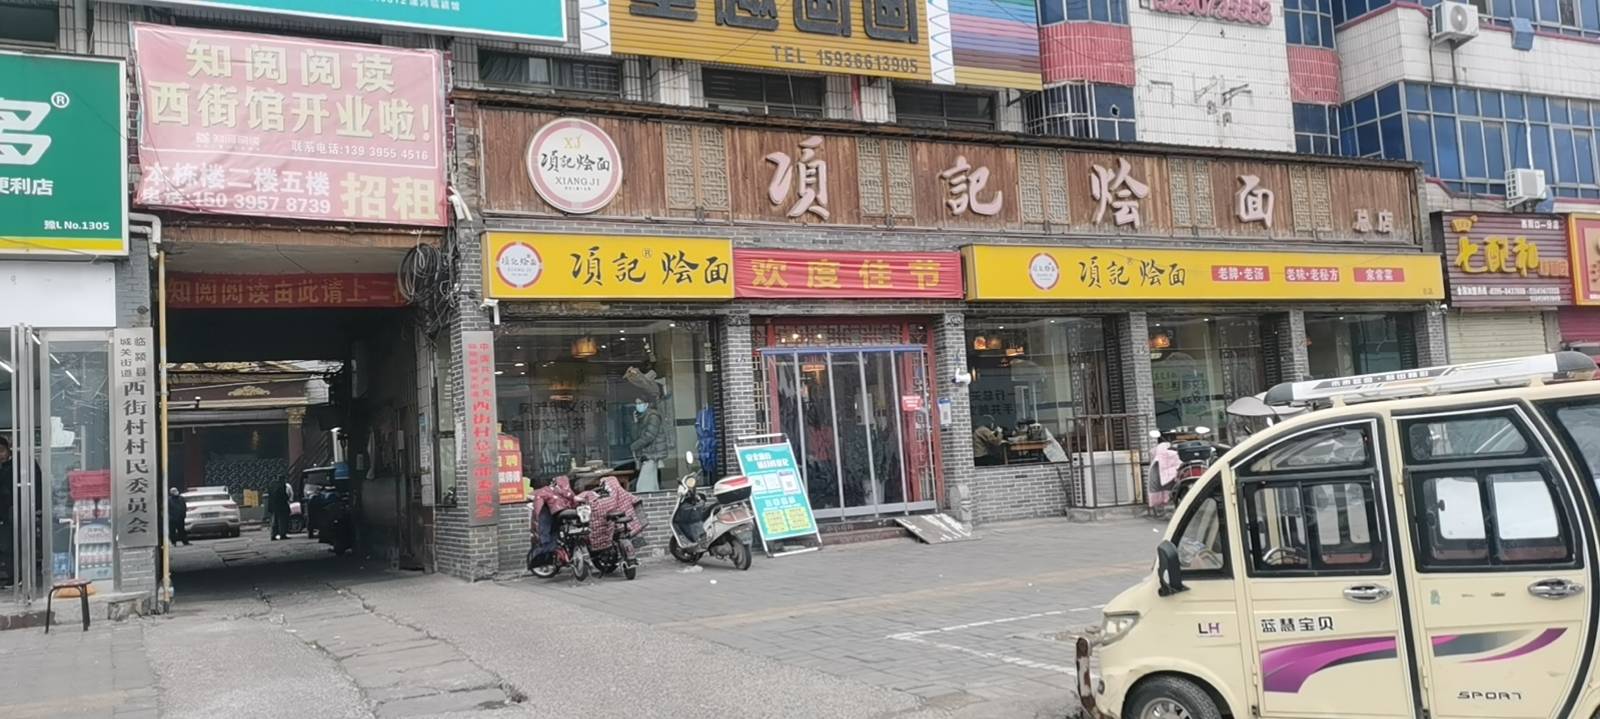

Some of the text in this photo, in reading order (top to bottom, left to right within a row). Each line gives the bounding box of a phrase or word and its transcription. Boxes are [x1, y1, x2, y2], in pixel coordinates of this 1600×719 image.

[185, 38, 395, 94] 知阅阅读
[771, 45, 918, 74] TEL 15936613905
[148, 81, 430, 142] 西街馆开业啦!
[369, 146, 397, 159] 3955
[401, 150, 429, 161] 4516
[144, 162, 331, 197] 本栋楼二楼五楼
[555, 176, 600, 187] XIANG JI
[233, 193, 279, 211] 3957
[286, 196, 332, 214] 8739
[339, 171, 441, 221] 招租
[64, 220, 110, 231] No.1305
[750, 257, 941, 290] 欢度佳节
[123, 380, 149, 534] 西街村村民委员会
[1197, 622, 1220, 635] LH
[1260, 616, 1334, 633] 蓝慧宝贝
[1457, 691, 1522, 700] SPORT
